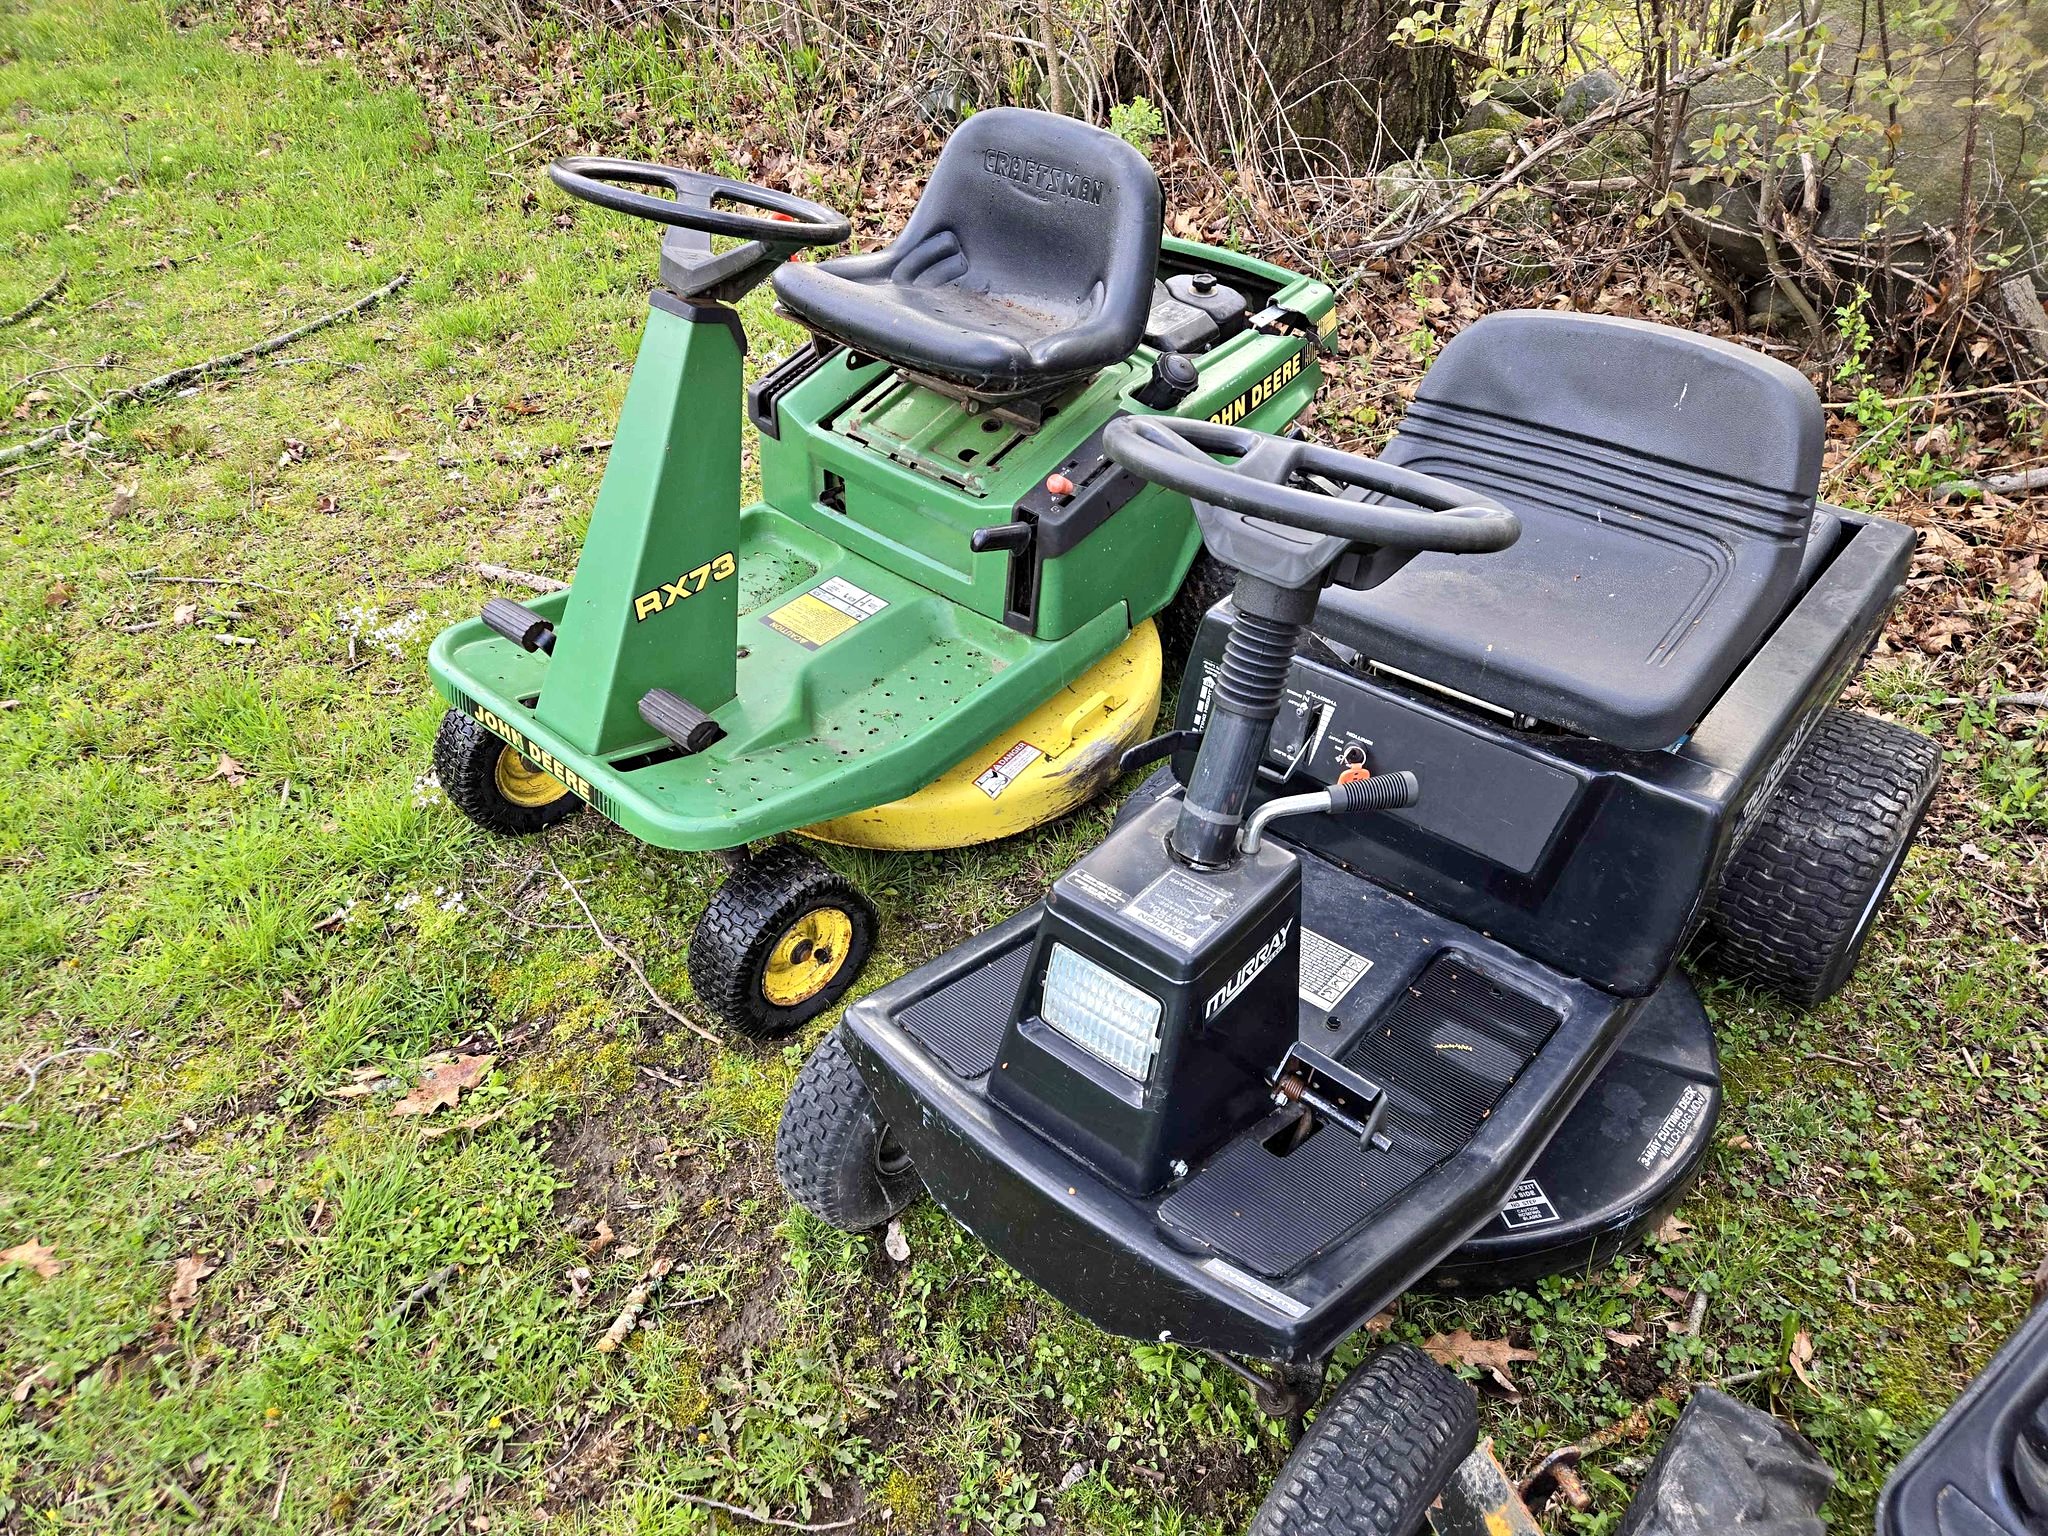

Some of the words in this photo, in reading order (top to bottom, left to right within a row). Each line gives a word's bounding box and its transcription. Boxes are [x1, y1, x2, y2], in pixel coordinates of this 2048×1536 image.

[984, 149, 1104, 206] CRAFTSMAN
[1251, 351, 1301, 409] DEERE
[633, 551, 736, 623] RX73
[769, 621, 803, 642] CAUTION
[1306, 689, 1337, 707] THROTTLE
[474, 705, 524, 750] JOHN
[528, 740, 591, 800] DEERE
[1000, 742, 1027, 767] DANGER
[1168, 877, 1212, 901] DISENGAGE
[1147, 900, 1193, 929] CONTROL
[1150, 908, 1183, 931] BLADE
[1158, 899, 1190, 919] ENGAGE
[1138, 912, 1188, 942] CAUTION
[1205, 918, 1294, 1019] MURRAY
[1640, 1138, 1662, 1166] 3-WAY
[1657, 1107, 1683, 1141] CUTTING
[1678, 1086, 1698, 1110] DECK
[1518, 1190, 1536, 1198] SIDE
